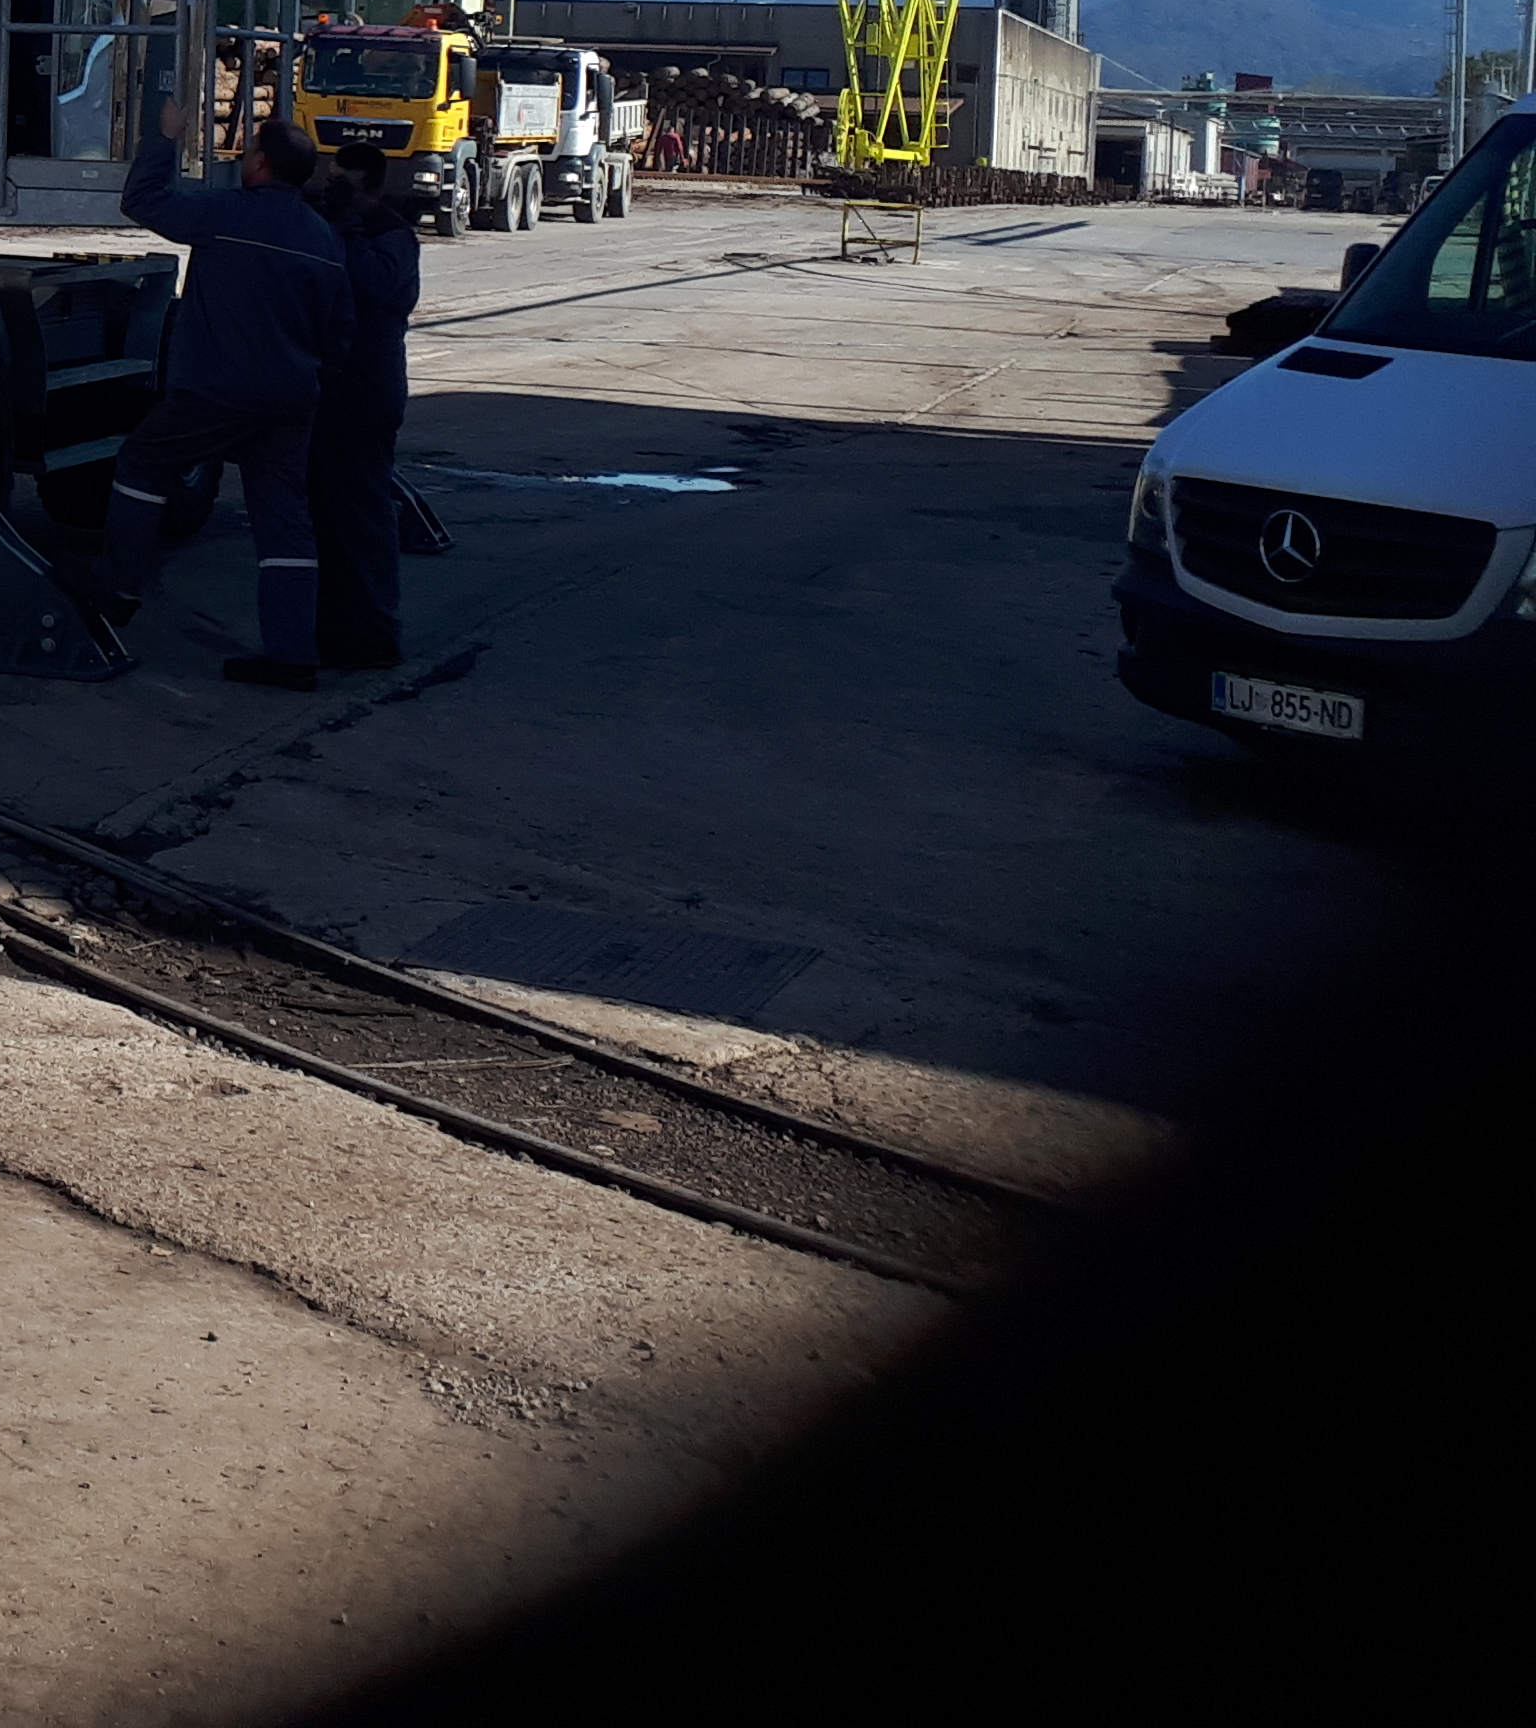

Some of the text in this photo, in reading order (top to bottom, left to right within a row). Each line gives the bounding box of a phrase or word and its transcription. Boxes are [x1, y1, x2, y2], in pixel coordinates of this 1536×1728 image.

[342, 128, 383, 138] MAN
[1230, 681, 1353, 729] LJ 855-ND
